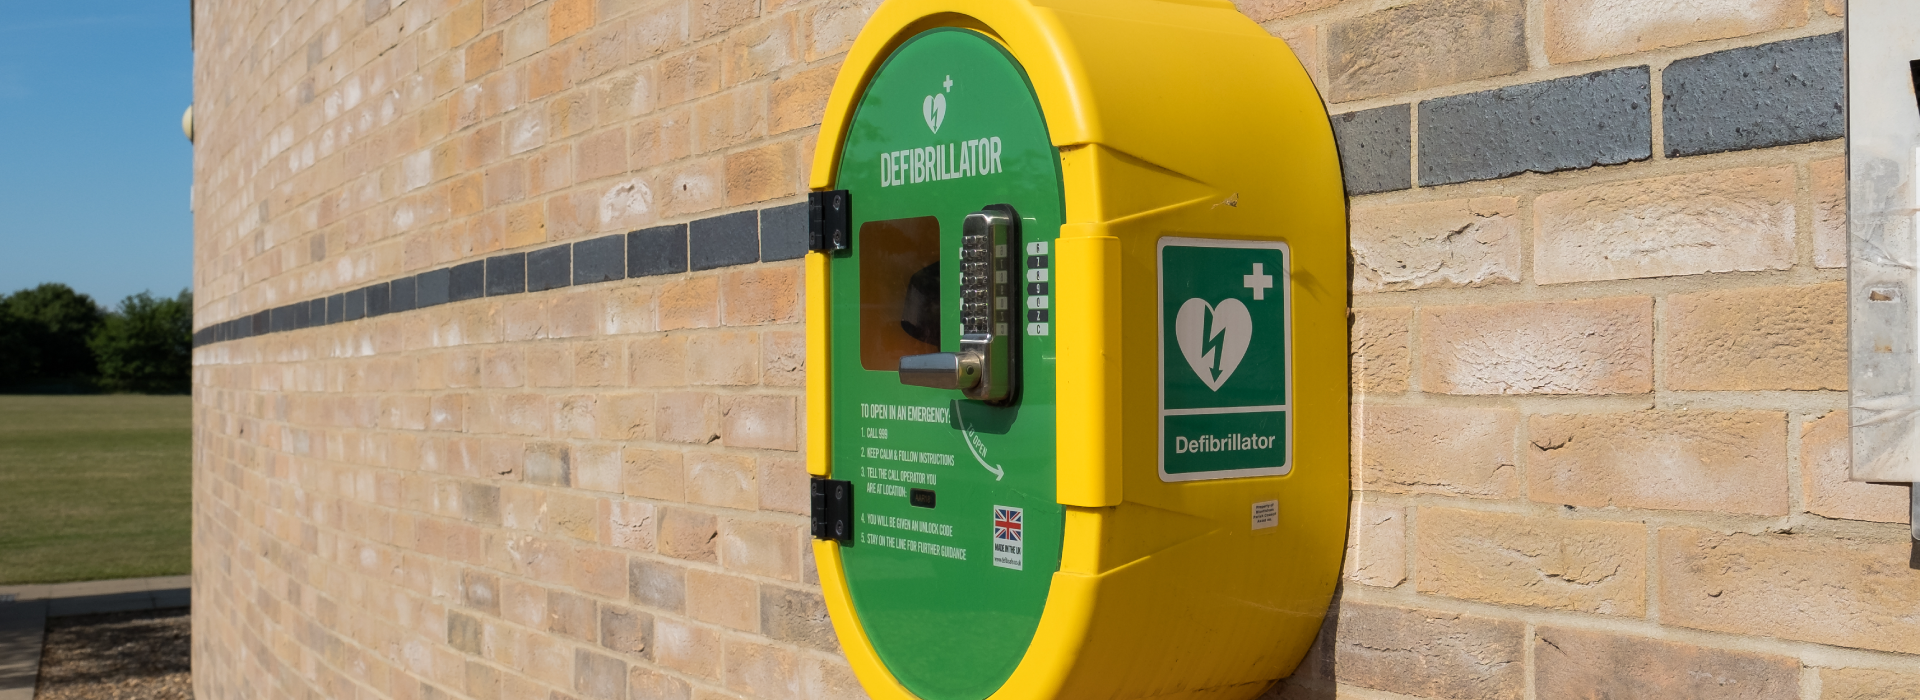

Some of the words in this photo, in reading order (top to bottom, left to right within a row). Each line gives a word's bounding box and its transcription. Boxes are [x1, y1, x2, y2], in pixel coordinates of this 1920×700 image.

[881, 136, 1002, 187] DEFIBRILLATOR
[861, 403, 869, 419] TO
[870, 404, 888, 420] OPEN
[889, 404, 896, 420] IN
[897, 405, 906, 421] AN
[907, 405, 951, 424] EMERGENCY:
[861, 427, 865, 438] 1.
[866, 427, 878, 439] CALL
[878, 428, 888, 440] 999
[967, 422, 975, 438] TO
[972, 435, 988, 458] OPEN
[1175, 433, 1276, 454] Defibrillator
[861, 447, 866, 458] 2.
[867, 447, 879, 459] KEEP
[880, 448, 893, 460] CALM
[894, 450, 898, 460] &
[898, 450, 918, 463] FOLLOW
[919, 451, 955, 466] INSTRUCTIONS
[861, 466, 866, 477] 3.
[867, 467, 877, 479] TELL
[878, 468, 887, 480] THE
[888, 469, 900, 481] CALL
[900, 470, 926, 484] OPERATOR
[926, 473, 937, 485] YOU
[866, 482, 876, 493] ARE
[876, 483, 883, 494] AT
[883, 484, 907, 498] LOCATION:
[861, 513, 865, 524] 4.
[867, 513, 877, 525] YOU
[877, 515, 889, 527] WILL
[889, 516, 896, 528] BE
[896, 517, 911, 531] GIVEN
[911, 519, 919, 531] AN
[919, 520, 939, 535] UNLOCK
[939, 523, 953, 537] CODE
[861, 532, 865, 543] 5.
[867, 533, 878, 545] STAY
[878, 535, 886, 547] ON
[886, 536, 895, 548] THE
[895, 537, 907, 550] LINE
[907, 538, 917, 552] FOR
[917, 541, 940, 556] FURTHER
[940, 545, 967, 561] GUIDANCE
[995, 543, 1005, 553] MADE
[1016, 546, 1021, 555] UK
